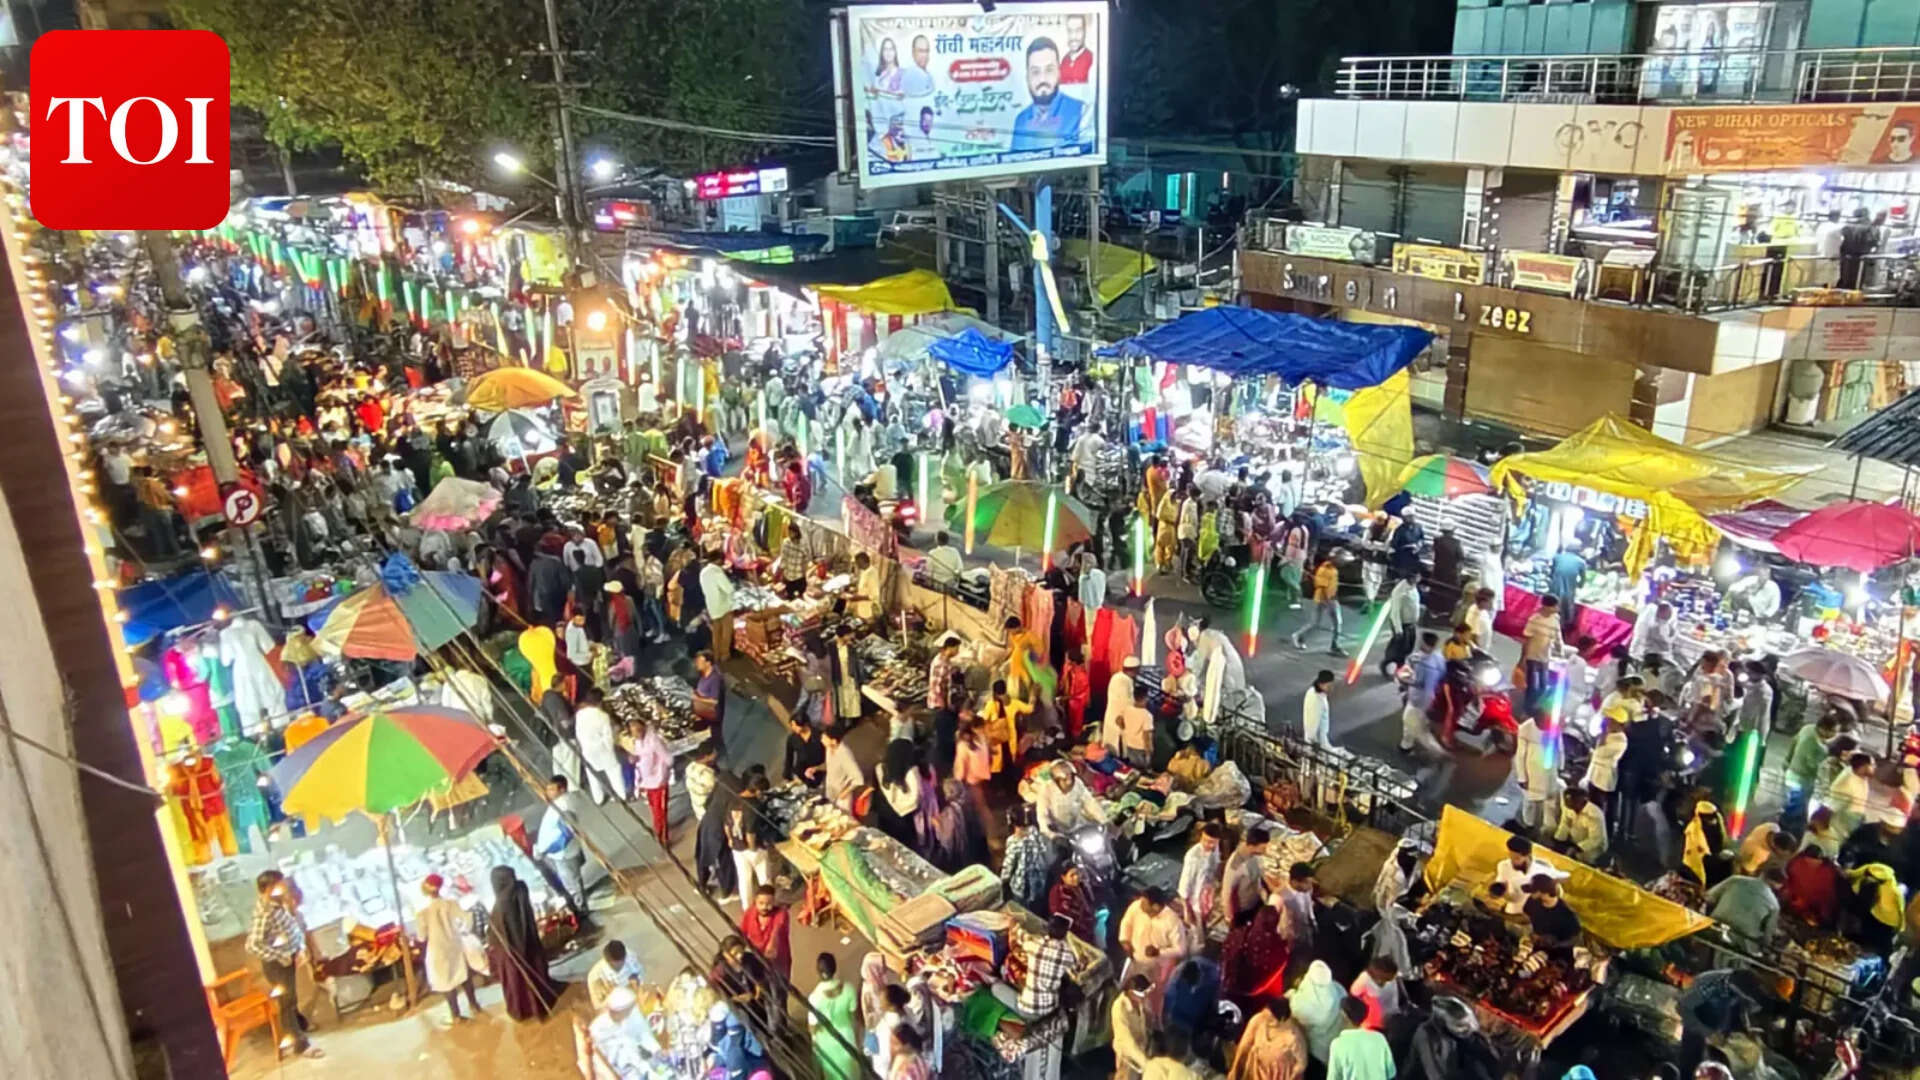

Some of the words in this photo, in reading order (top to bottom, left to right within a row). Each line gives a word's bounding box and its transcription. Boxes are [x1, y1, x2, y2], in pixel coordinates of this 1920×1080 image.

[1676, 114, 1710, 129] NEW
[1714, 113, 1763, 128] BIHAR
[1768, 112, 1847, 128] OPTICALS
